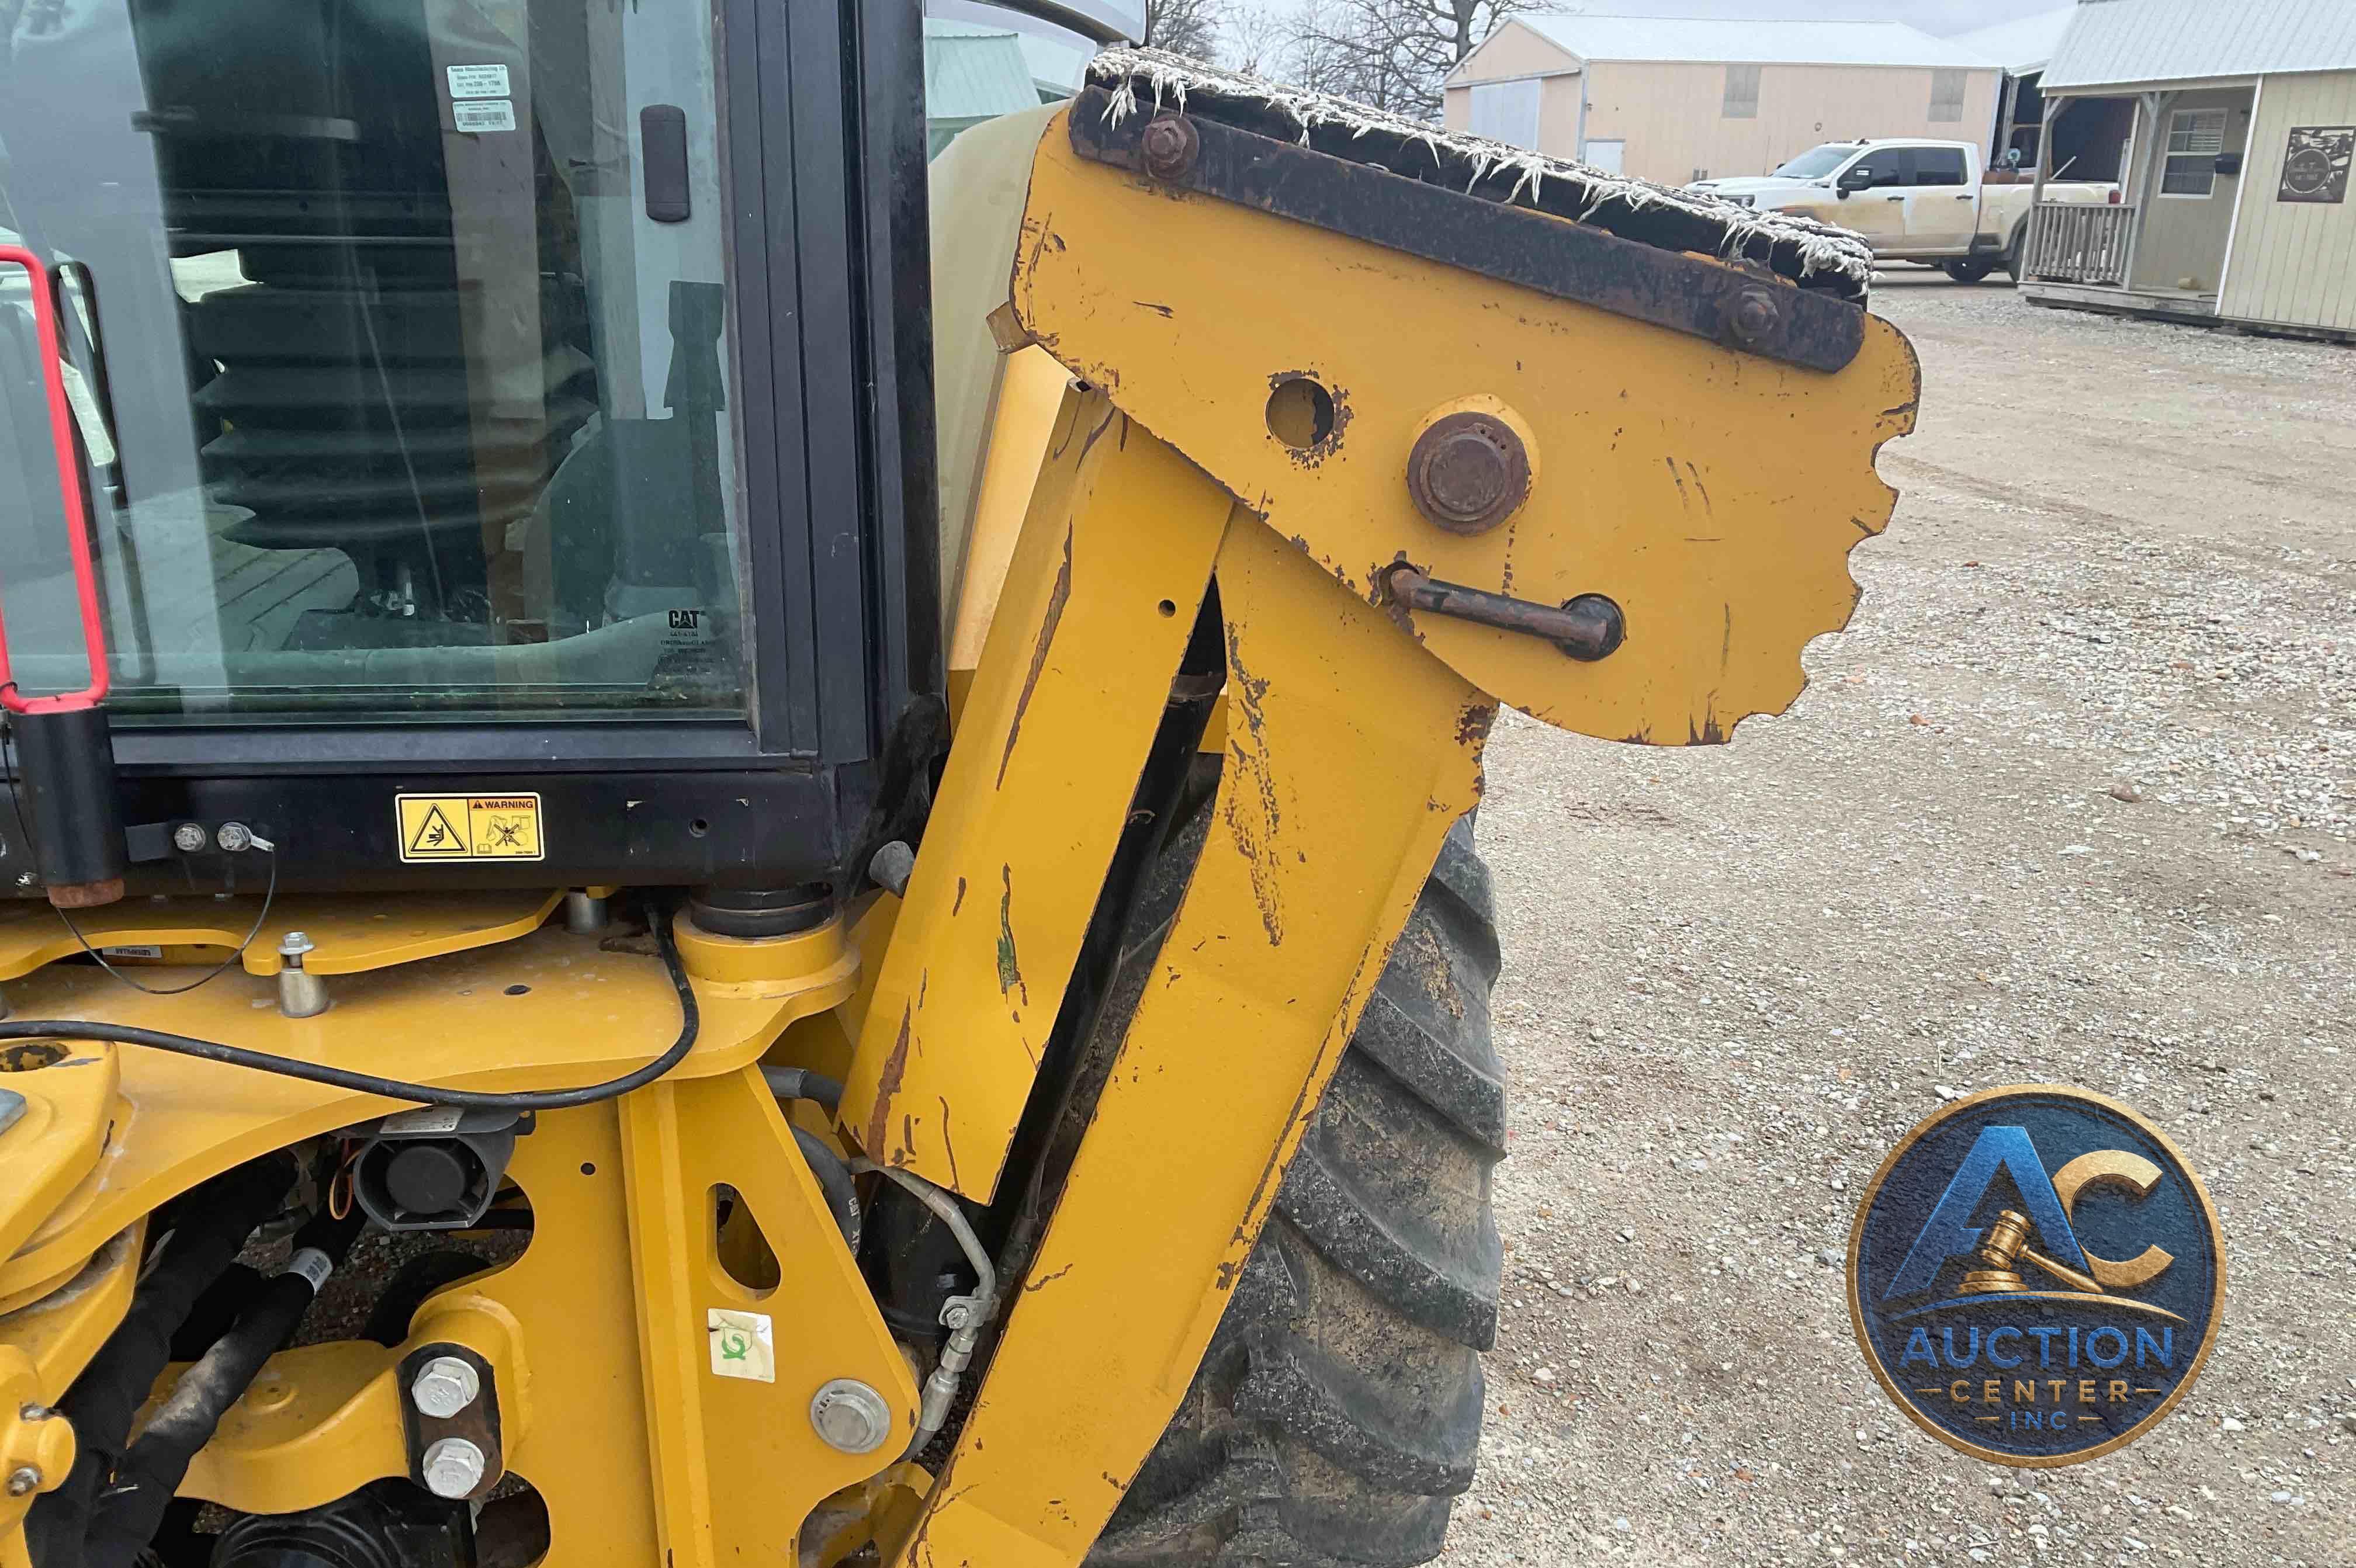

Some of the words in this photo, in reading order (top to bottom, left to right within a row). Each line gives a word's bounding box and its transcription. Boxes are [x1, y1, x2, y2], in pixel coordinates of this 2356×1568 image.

[668, 610, 699, 629] CAT
[484, 800, 533, 809] WARNING
[848, 1196, 861, 1217] CAT
